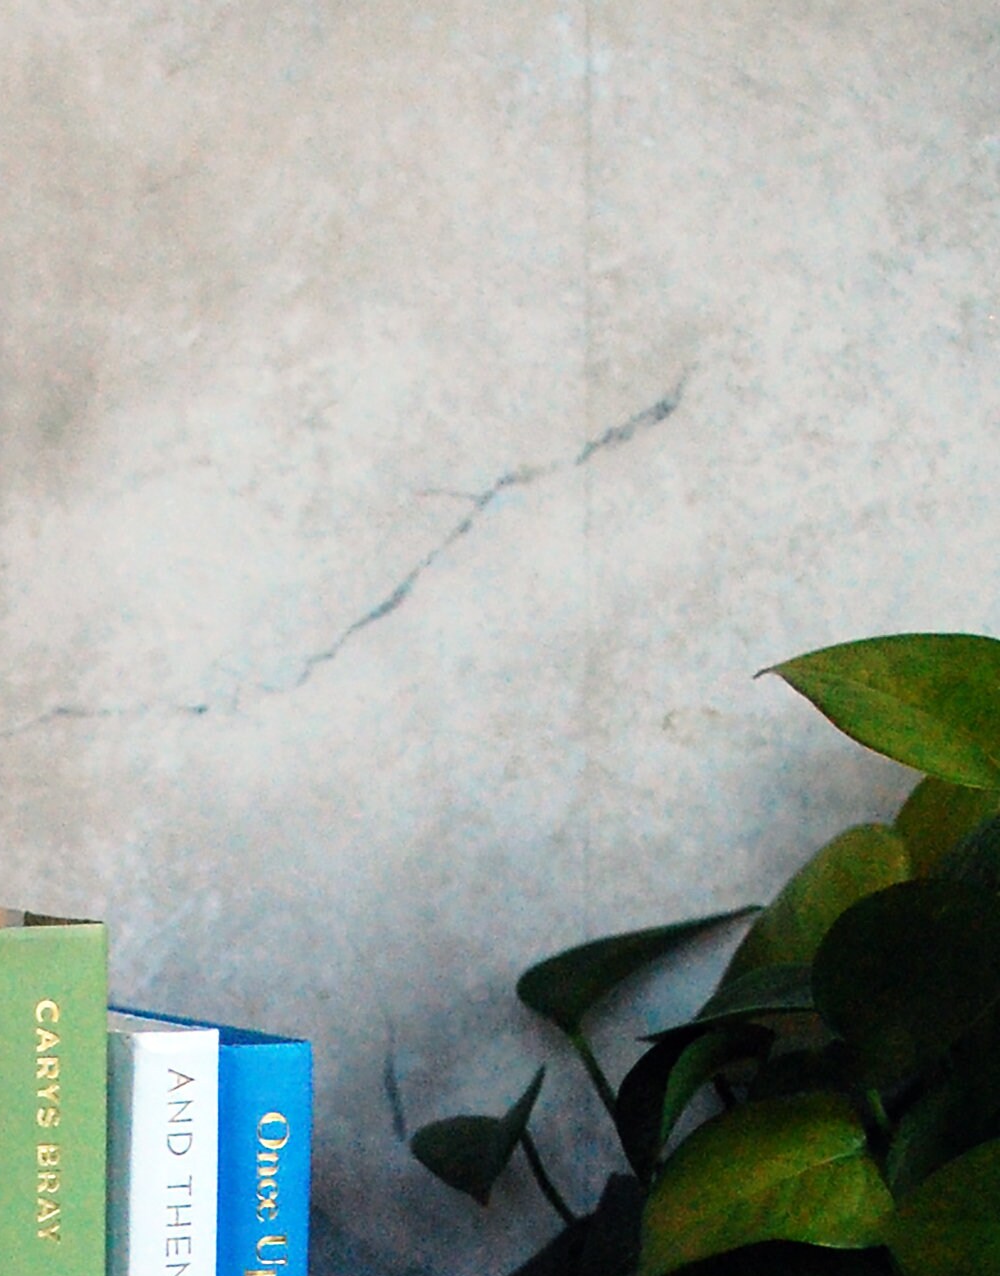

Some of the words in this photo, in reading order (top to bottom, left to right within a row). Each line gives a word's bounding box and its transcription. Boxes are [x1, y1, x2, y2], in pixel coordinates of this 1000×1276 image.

[35, 999, 61, 1129] CARYS
[165, 1068, 197, 1157] AND
[35, 1144, 62, 1245] BRAY
[255, 1111, 290, 1223] Once
